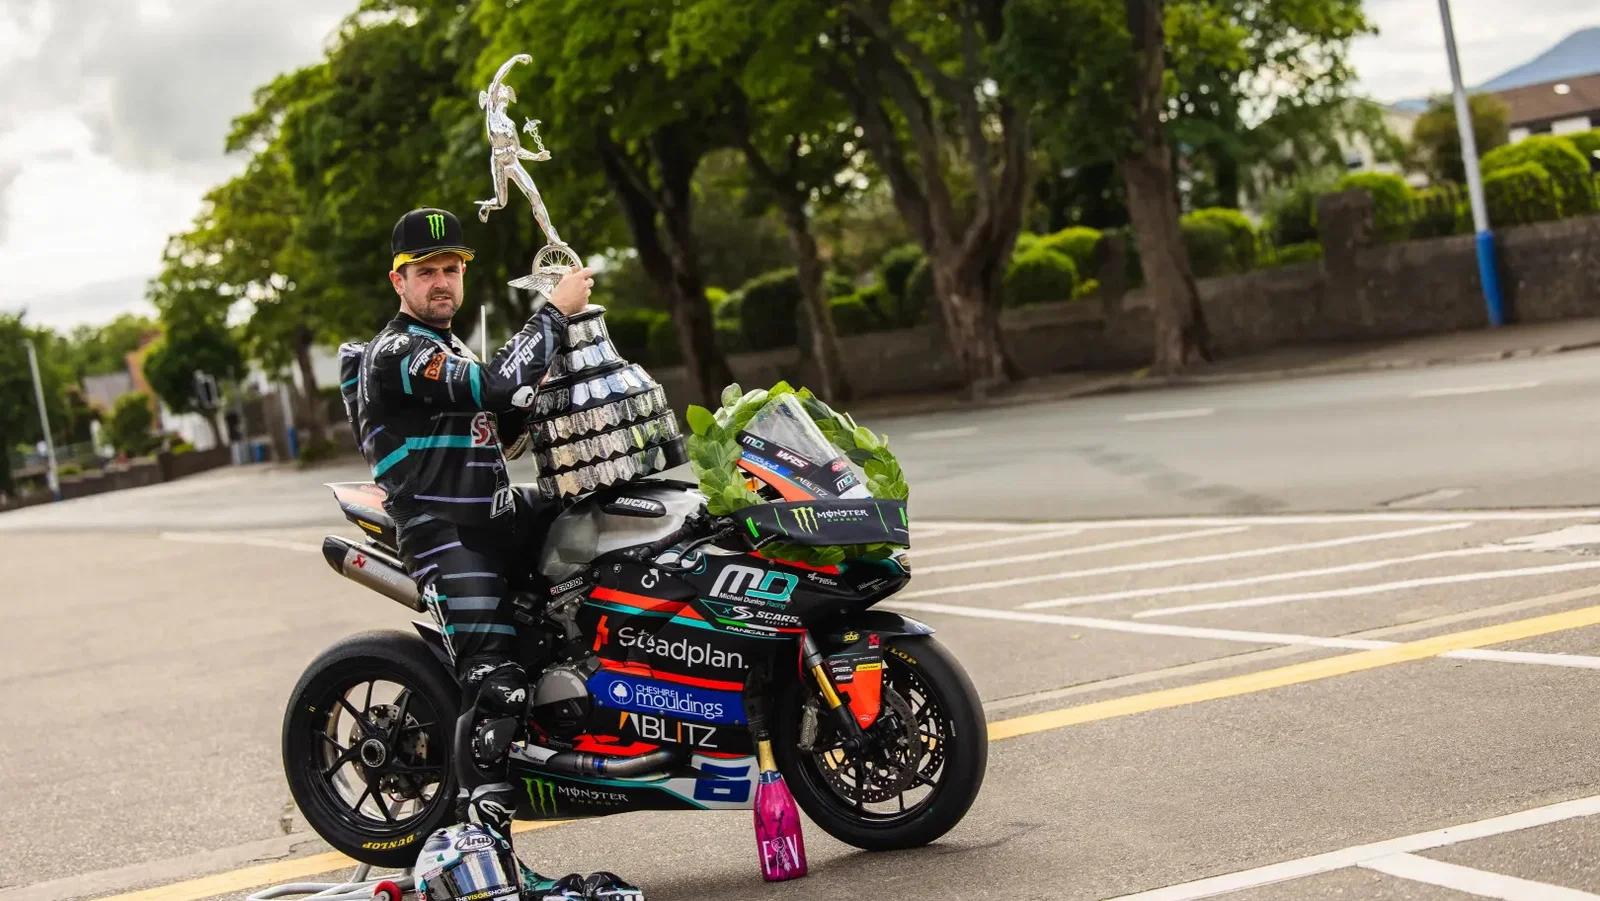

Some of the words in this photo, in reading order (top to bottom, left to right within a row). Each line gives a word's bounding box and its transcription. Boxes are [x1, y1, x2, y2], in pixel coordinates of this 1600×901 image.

[498, 332, 543, 379] furygan
[615, 497, 658, 511] DUCATI
[816, 509, 869, 520] MONSTER
[718, 592, 743, 602] Michael
[743, 596, 766, 607] Dunlop
[766, 600, 787, 610] Racing
[756, 610, 799, 623] SCARS
[726, 625, 777, 637] PANIGALE
[636, 683, 676, 698] CHESHIRE
[636, 690, 724, 720] mouldings
[558, 785, 629, 802] MONSTER
[362, 833, 415, 850] DUNLOP
[458, 834, 491, 848] Arai
